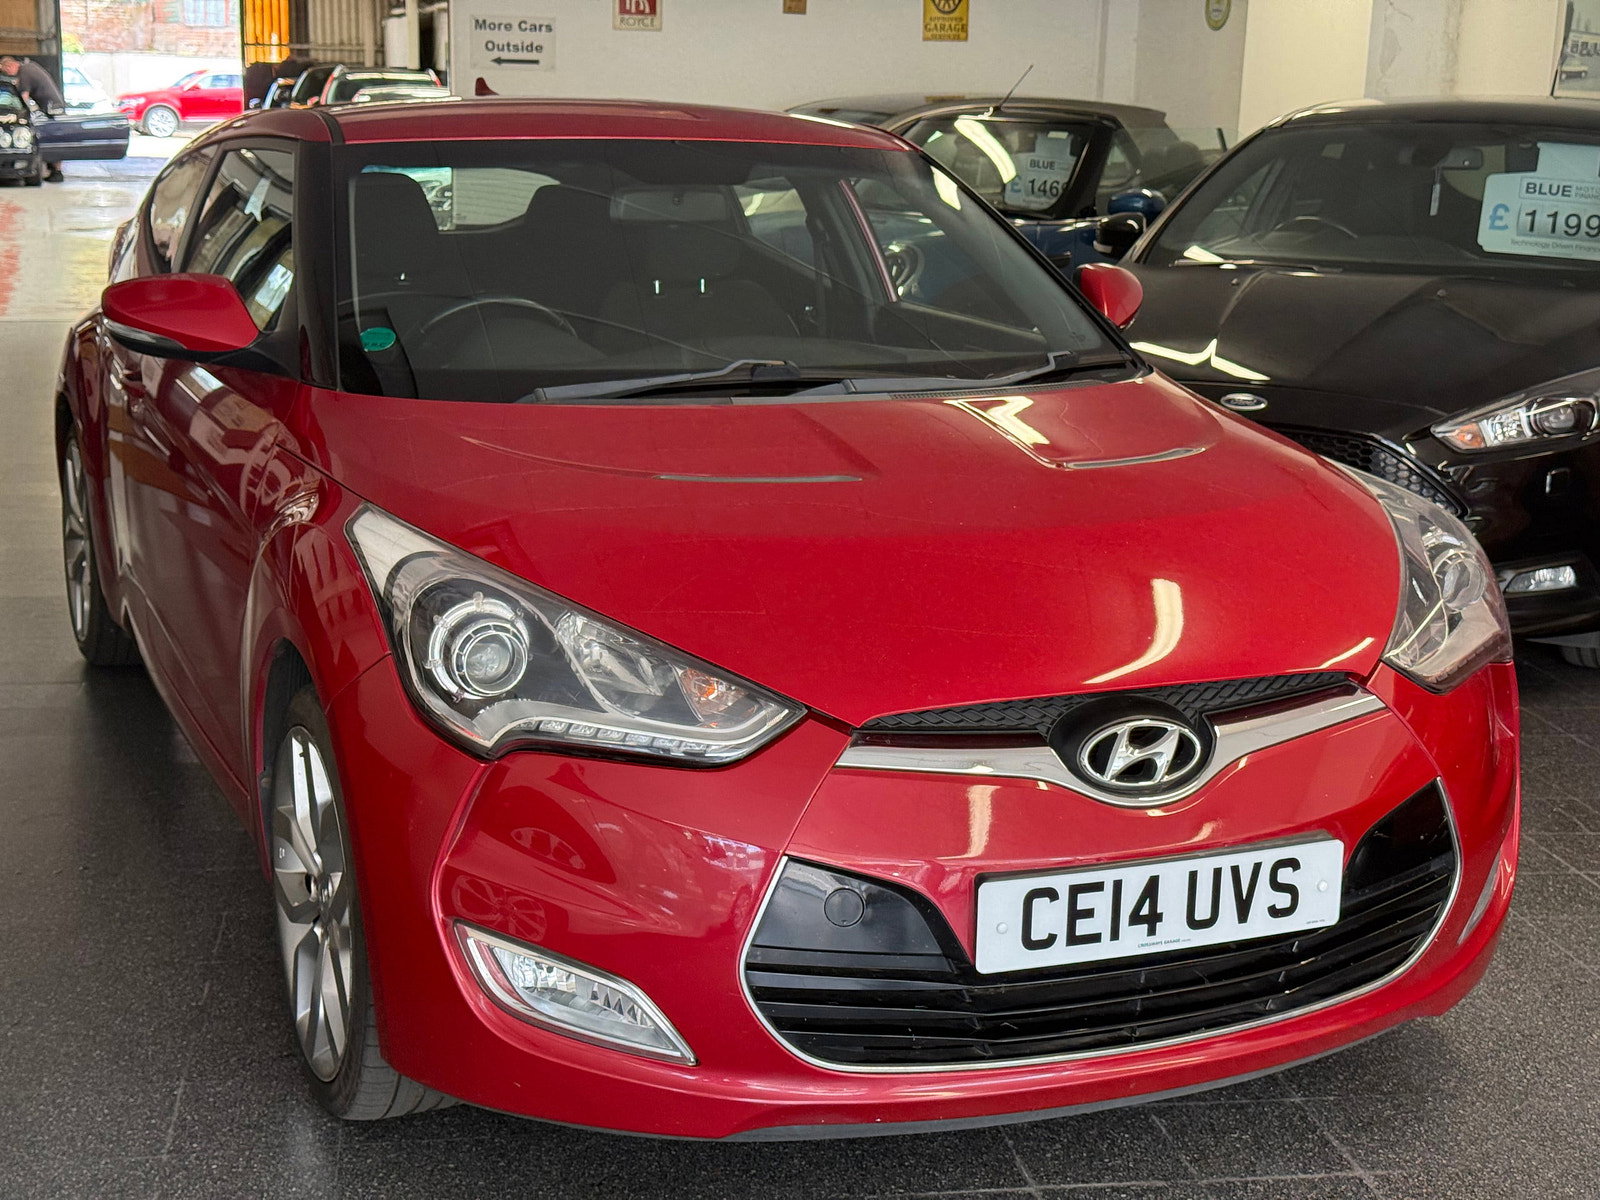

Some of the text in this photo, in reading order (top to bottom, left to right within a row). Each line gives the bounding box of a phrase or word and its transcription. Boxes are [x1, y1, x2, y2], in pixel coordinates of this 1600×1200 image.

[474, 19, 553, 33] More Cars
[925, 23, 967, 33] GARAGE
[485, 40, 543, 53] Outside
[1029, 159, 1056, 170] BLUE
[1525, 182, 1572, 197] BLUE
[1488, 203, 1600, 238] £ 1199
[1020, 857, 1301, 951] CE14 UVS
